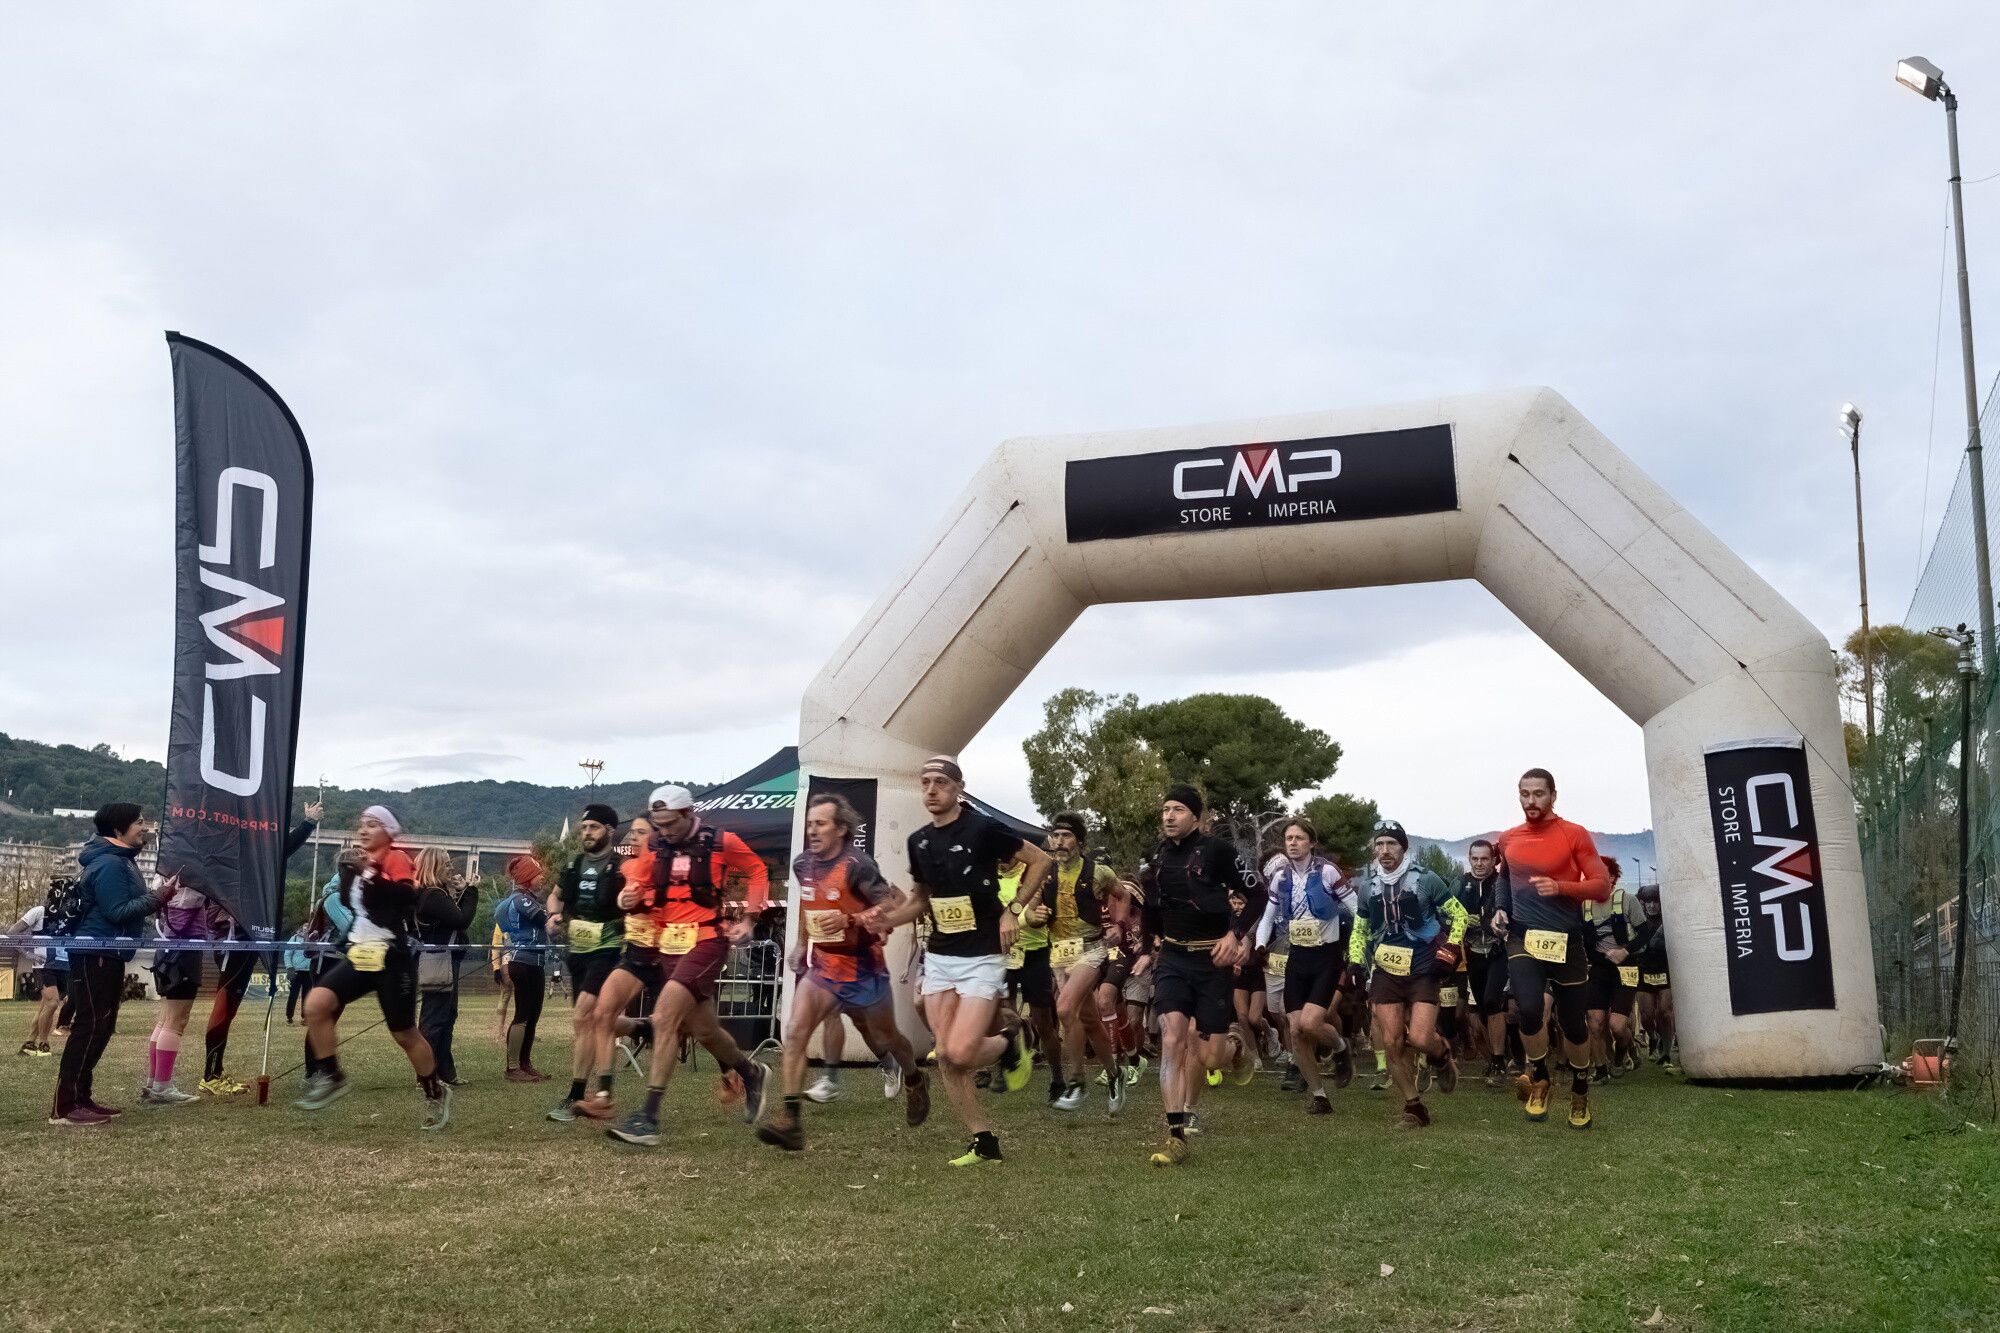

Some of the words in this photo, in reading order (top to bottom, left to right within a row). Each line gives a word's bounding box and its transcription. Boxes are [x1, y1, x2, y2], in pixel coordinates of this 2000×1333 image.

[1173, 448, 1342, 500] CMP
[1180, 506, 1232, 524] STORE
[1268, 500, 1337, 518] IMPERIA
[1718, 786, 1741, 844] STORE
[1731, 883, 1753, 958] IMPERIA
[1746, 772, 1813, 961] CMP
[940, 907, 962, 919] 120
[1295, 927, 1313, 937] 228
[1535, 939, 1557, 950] 187
[1058, 948, 1075, 958] 184
[1383, 952, 1402, 965] 242
